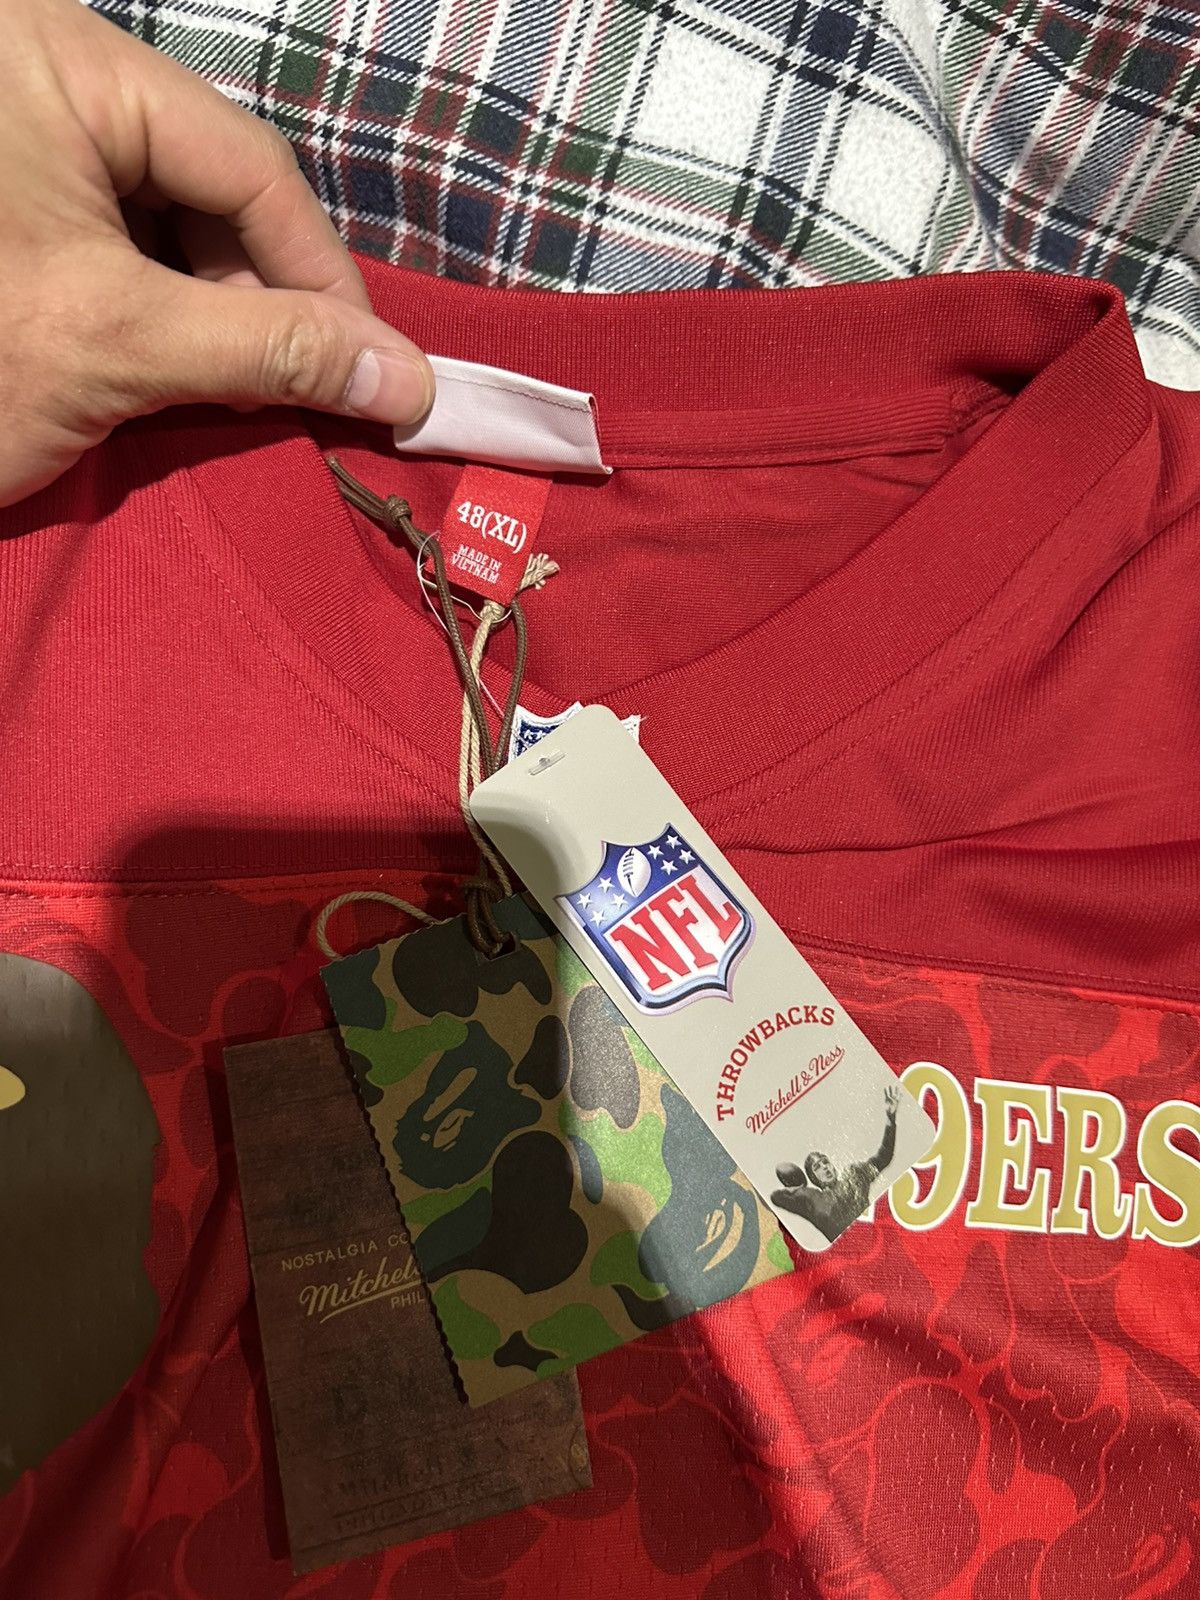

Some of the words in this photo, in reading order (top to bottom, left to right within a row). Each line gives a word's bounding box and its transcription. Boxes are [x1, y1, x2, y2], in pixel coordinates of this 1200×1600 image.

[457, 501, 527, 554] 48(XL)
[458, 544, 489, 566] MADE
[489, 558, 502, 571] IN
[451, 552, 500, 584] VIETNAM
[610, 874, 743, 991] NFL
[717, 1004, 835, 1121] THROWBACKS
[745, 1080, 802, 1134] Mitchell
[800, 1070, 813, 1085] &
[808, 1045, 845, 1078] Ness
[856, 1061, 1200, 1248] 9ERS
[281, 1240, 378, 1271] NOSTALGIA
